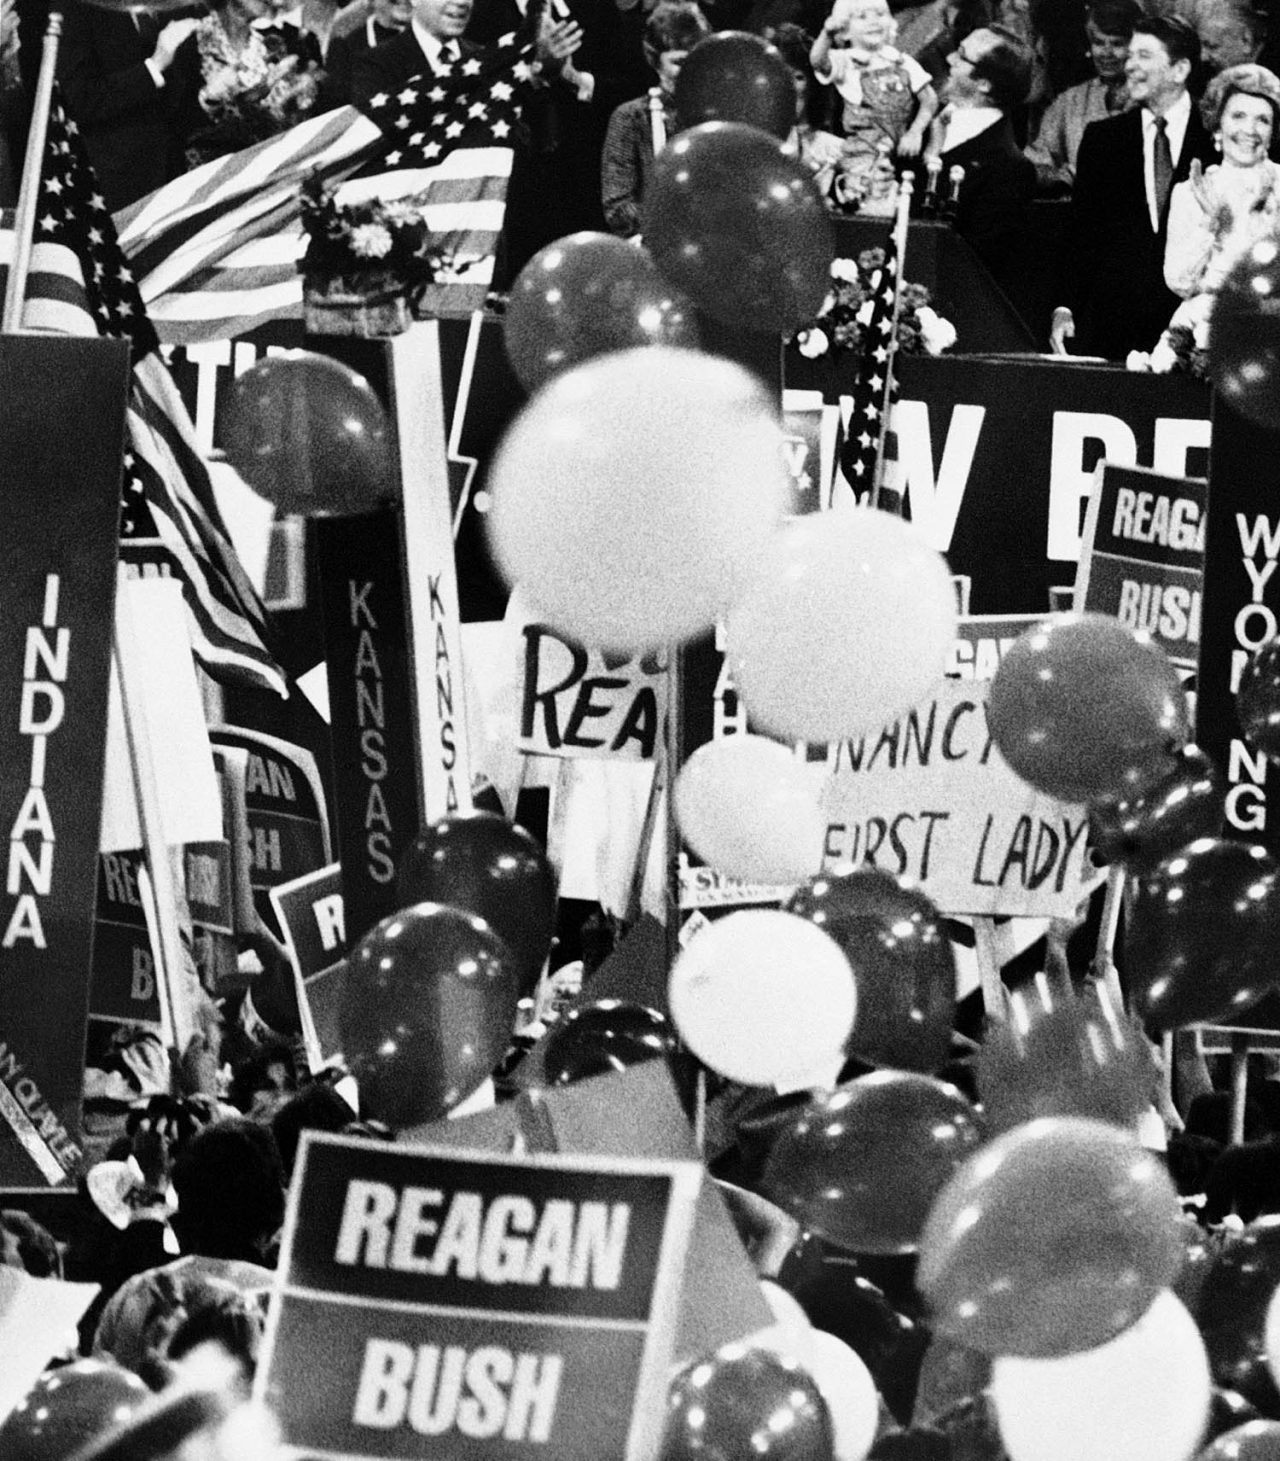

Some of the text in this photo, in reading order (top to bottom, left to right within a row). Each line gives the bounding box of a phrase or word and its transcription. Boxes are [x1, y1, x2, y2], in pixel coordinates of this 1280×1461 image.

[1112, 487, 1206, 552] REAG
[2, 574, 70, 949] INDIANA
[350, 580, 394, 883] KANSAS
[820, 811, 1089, 893] FIRST LADY
[334, 1178, 630, 1291] REAGAN
[352, 1337, 564, 1444] BUSH
